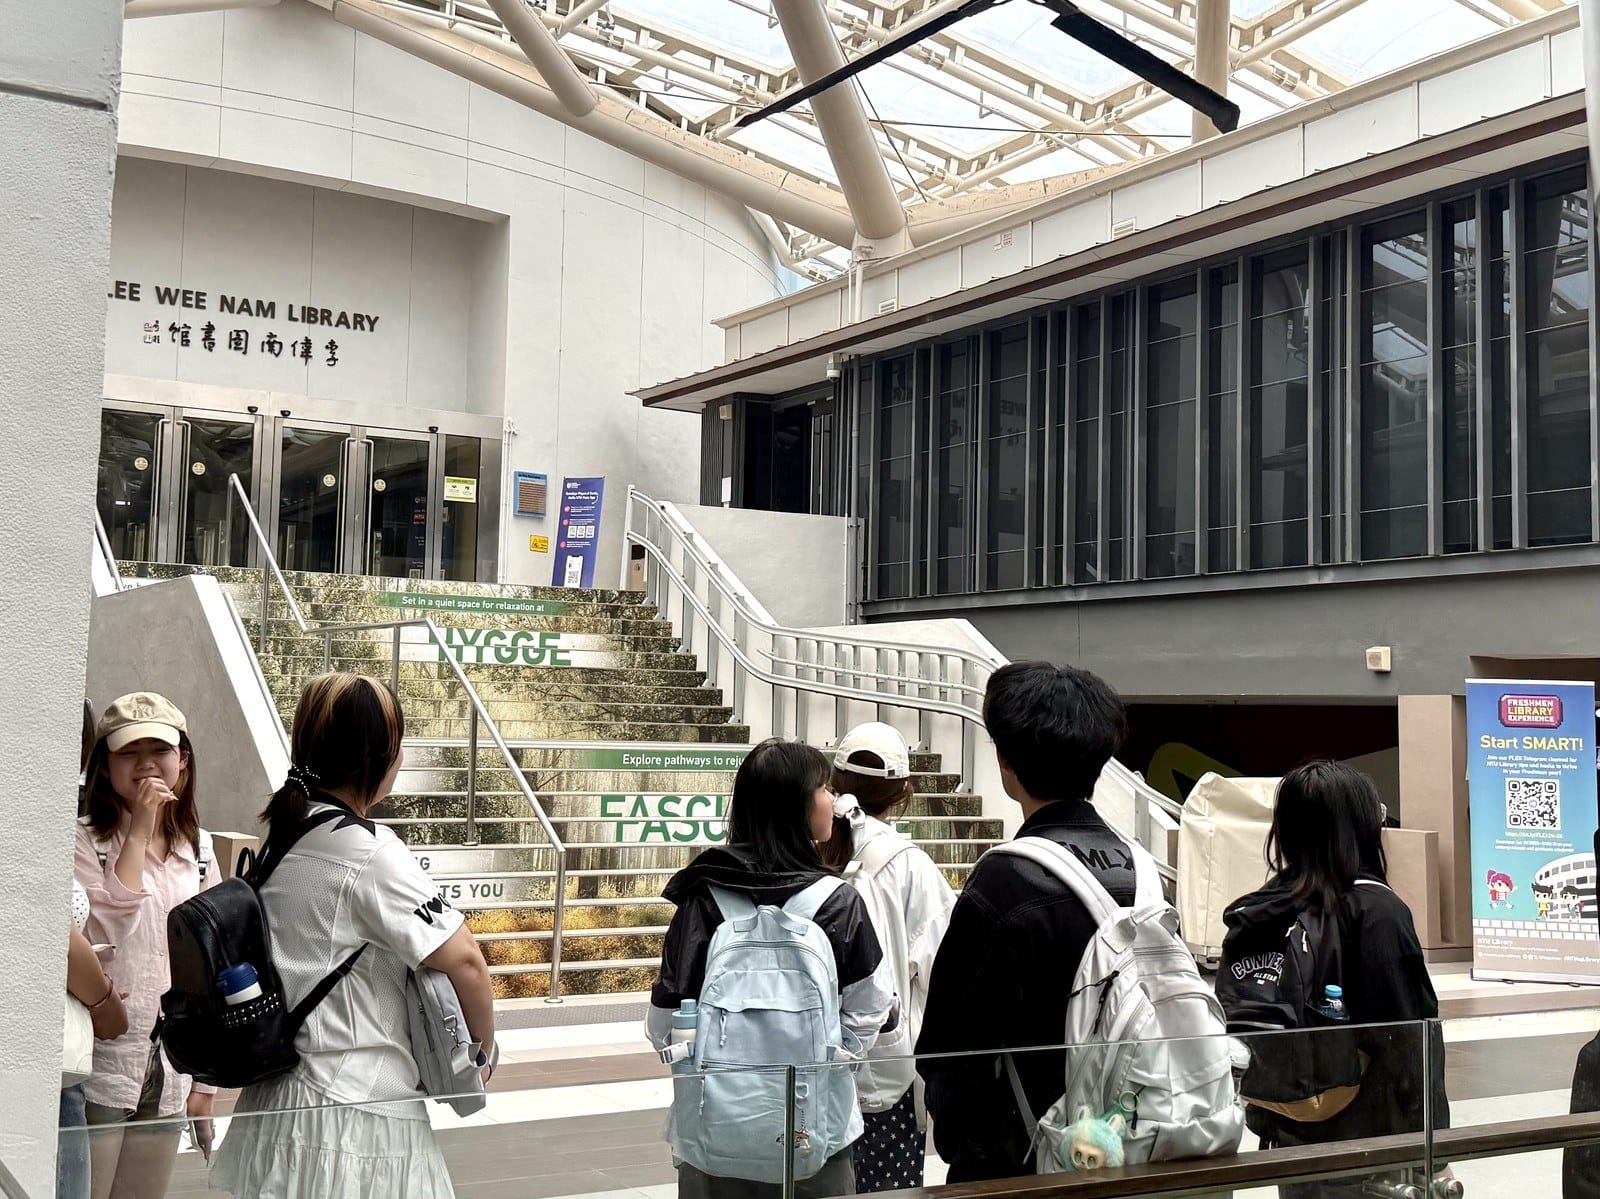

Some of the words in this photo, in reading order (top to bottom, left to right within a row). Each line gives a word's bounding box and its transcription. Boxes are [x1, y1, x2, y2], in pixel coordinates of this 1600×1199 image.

[108, 280, 141, 302] EE
[155, 286, 208, 310] WEE
[219, 295, 276, 319] NAM
[288, 304, 380, 332] LIBRARY
[402, 596, 416, 605] Set
[418, 597, 426, 605] in
[435, 598, 455, 608] quiet
[457, 601, 480, 609] space
[482, 600, 494, 609] for
[495, 601, 535, 611] relaxation
[536, 604, 545, 612] at
[1507, 699, 1554, 708] FRESHMEN
[1507, 706, 1554, 716] LIBRARY
[1480, 735, 1518, 749] Start
[1522, 736, 1584, 751] SMART!
[623, 754, 661, 767] Explore
[664, 755, 711, 768] pathways
[713, 756, 723, 765] to
[470, 883, 504, 898] YOU
